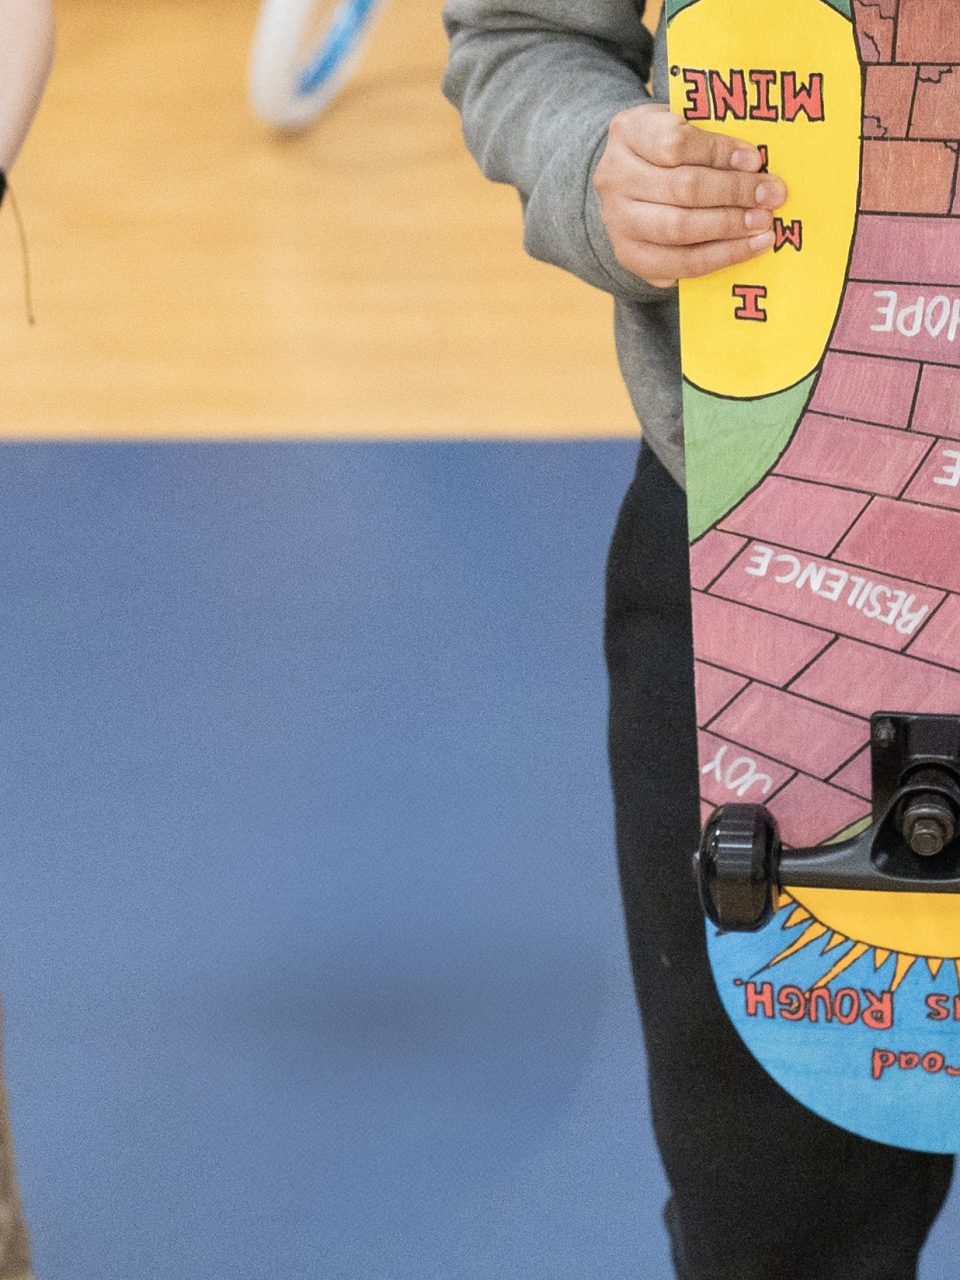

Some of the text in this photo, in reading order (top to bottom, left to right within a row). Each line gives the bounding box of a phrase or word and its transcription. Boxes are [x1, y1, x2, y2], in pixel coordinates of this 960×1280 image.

[670, 65, 825, 123] MINE.
[731, 283, 768, 322] I
[745, 544, 929, 635] RESILENCE
[701, 744, 773, 798] JOY
[733, 977, 894, 1030] ROUGH.
